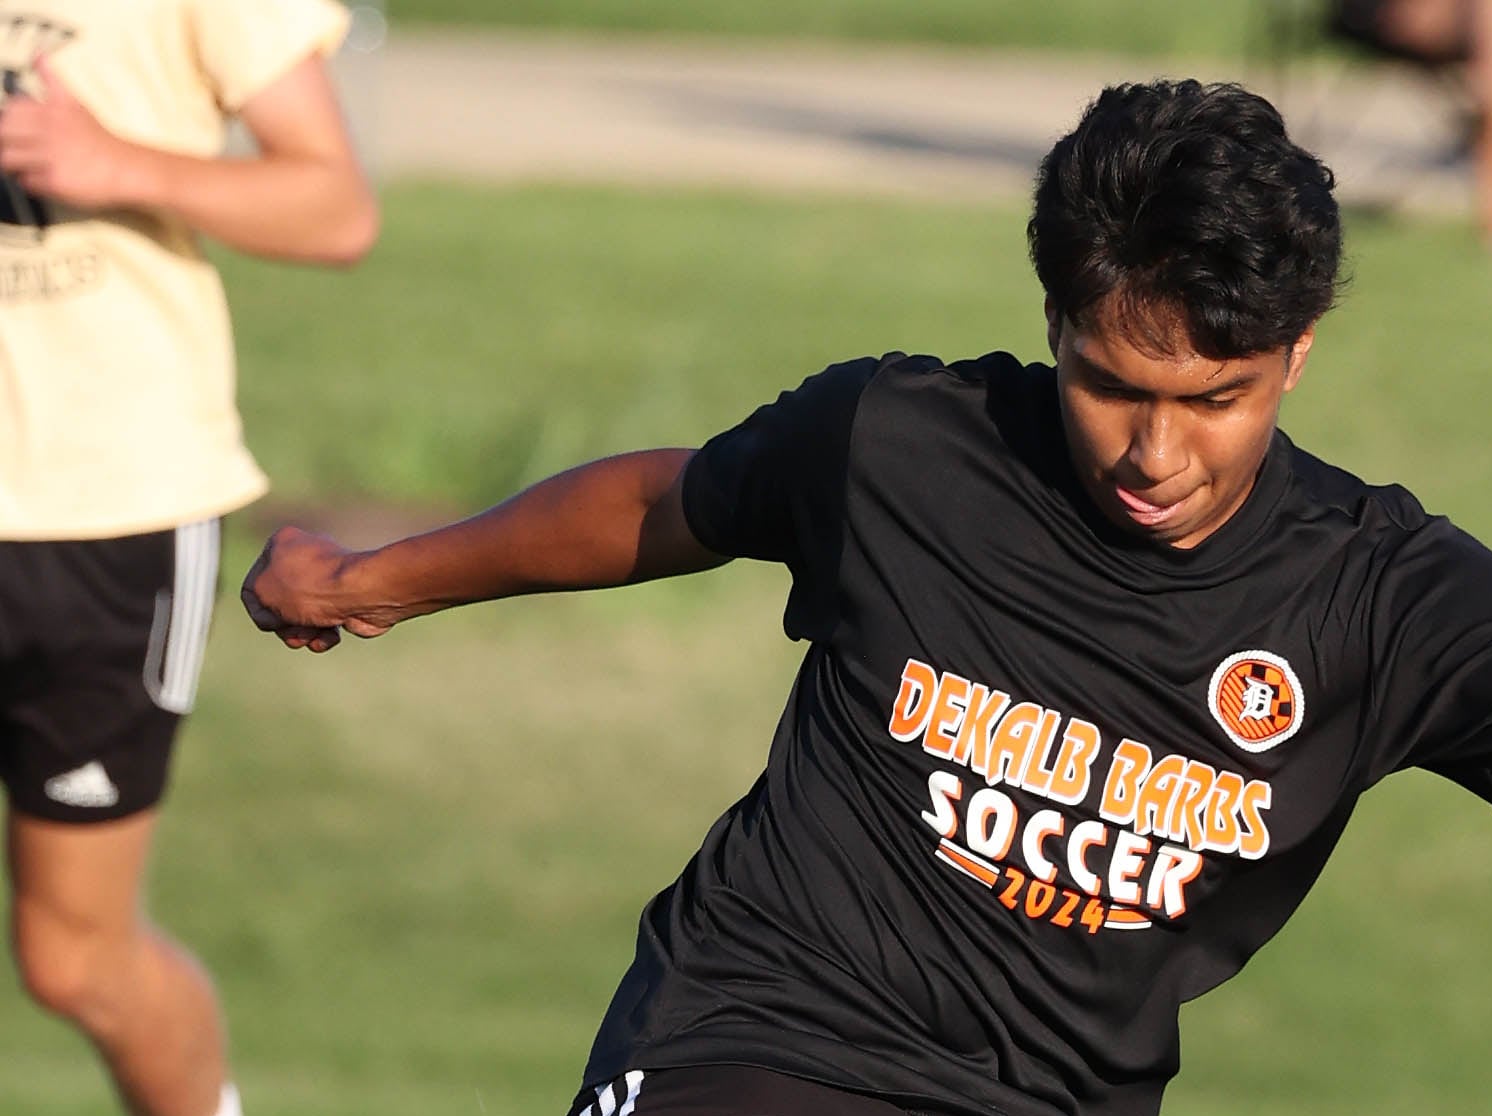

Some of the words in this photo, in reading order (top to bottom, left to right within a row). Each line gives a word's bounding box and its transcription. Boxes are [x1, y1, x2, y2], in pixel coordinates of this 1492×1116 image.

[889, 658, 1101, 806] DEKALB
[1099, 737, 1273, 860] BARBS
[921, 770, 1203, 919] SOCCER
[998, 866, 1106, 935] 2024
